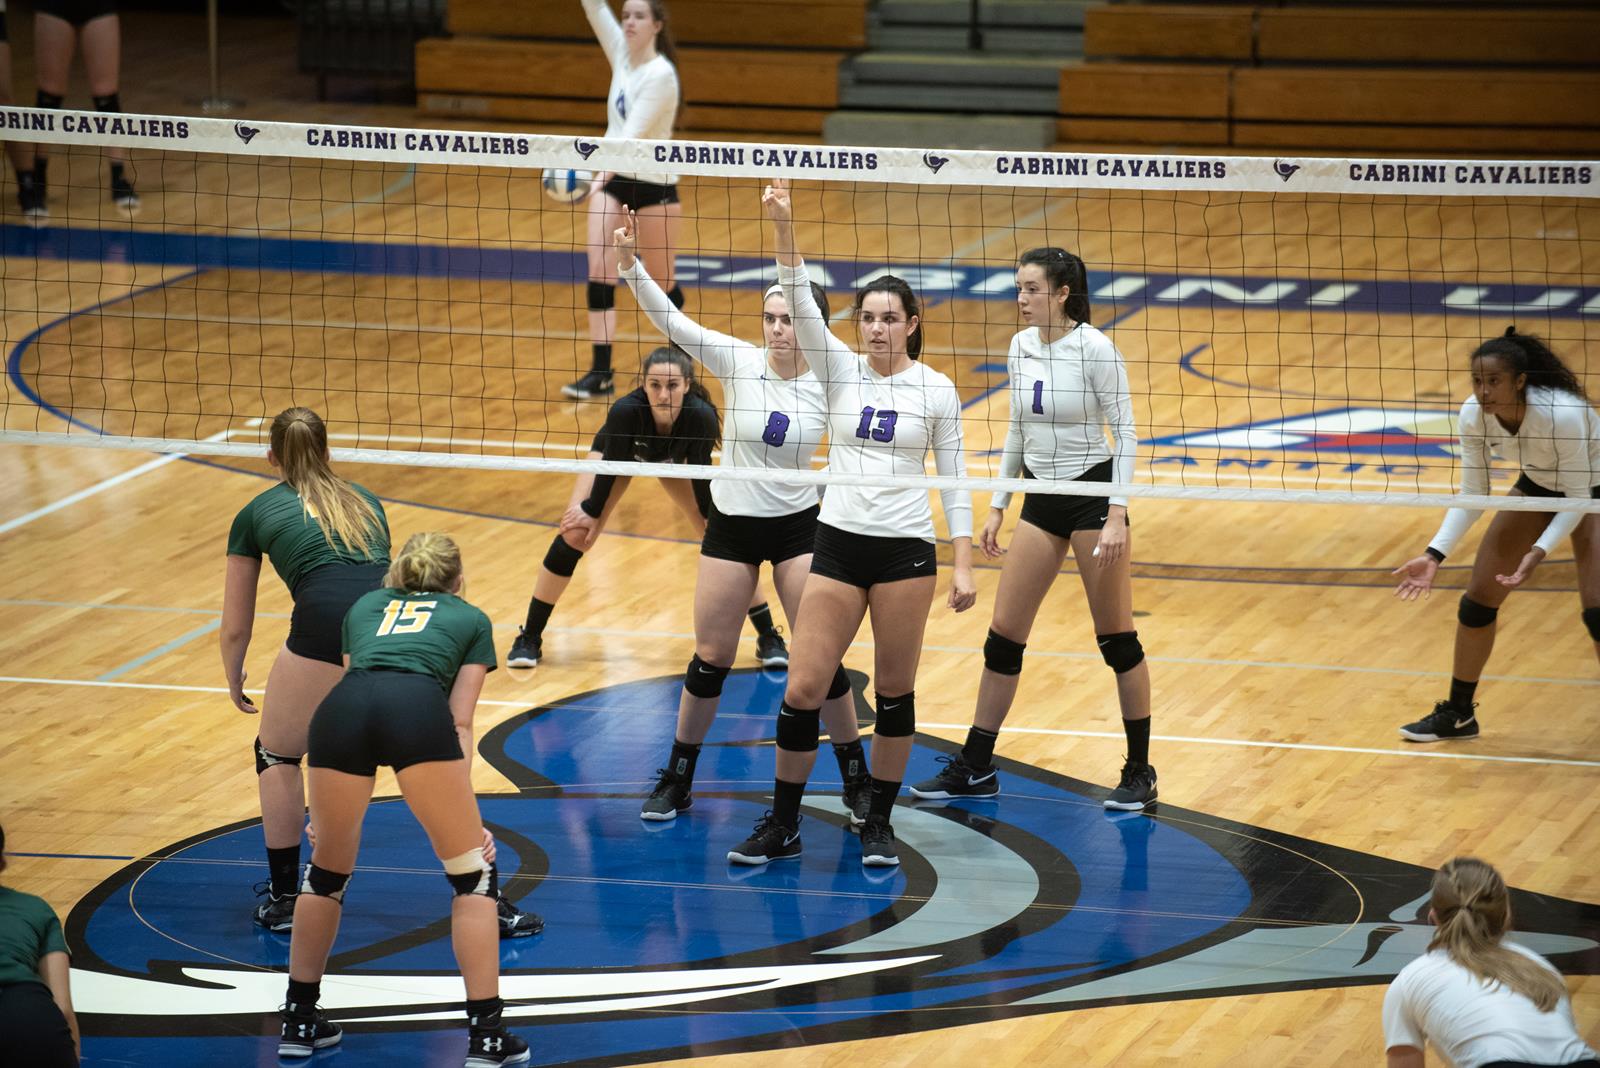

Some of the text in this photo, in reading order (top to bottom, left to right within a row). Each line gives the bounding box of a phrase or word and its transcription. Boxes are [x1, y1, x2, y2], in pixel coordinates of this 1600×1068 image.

[62, 115, 189, 138] CAVALIERS
[306, 129, 529, 155] CABRINI CAVALIERS
[654, 145, 878, 170] CABRINI CAVALIERS
[996, 156, 1226, 179] CABRINI CAVALIERS
[1349, 164, 1592, 185] CABRINI CAVALIERS
[1032, 380, 1044, 415] 1
[762, 411, 790, 447] 8
[856, 405, 898, 443] 13
[376, 599, 437, 637] 15
